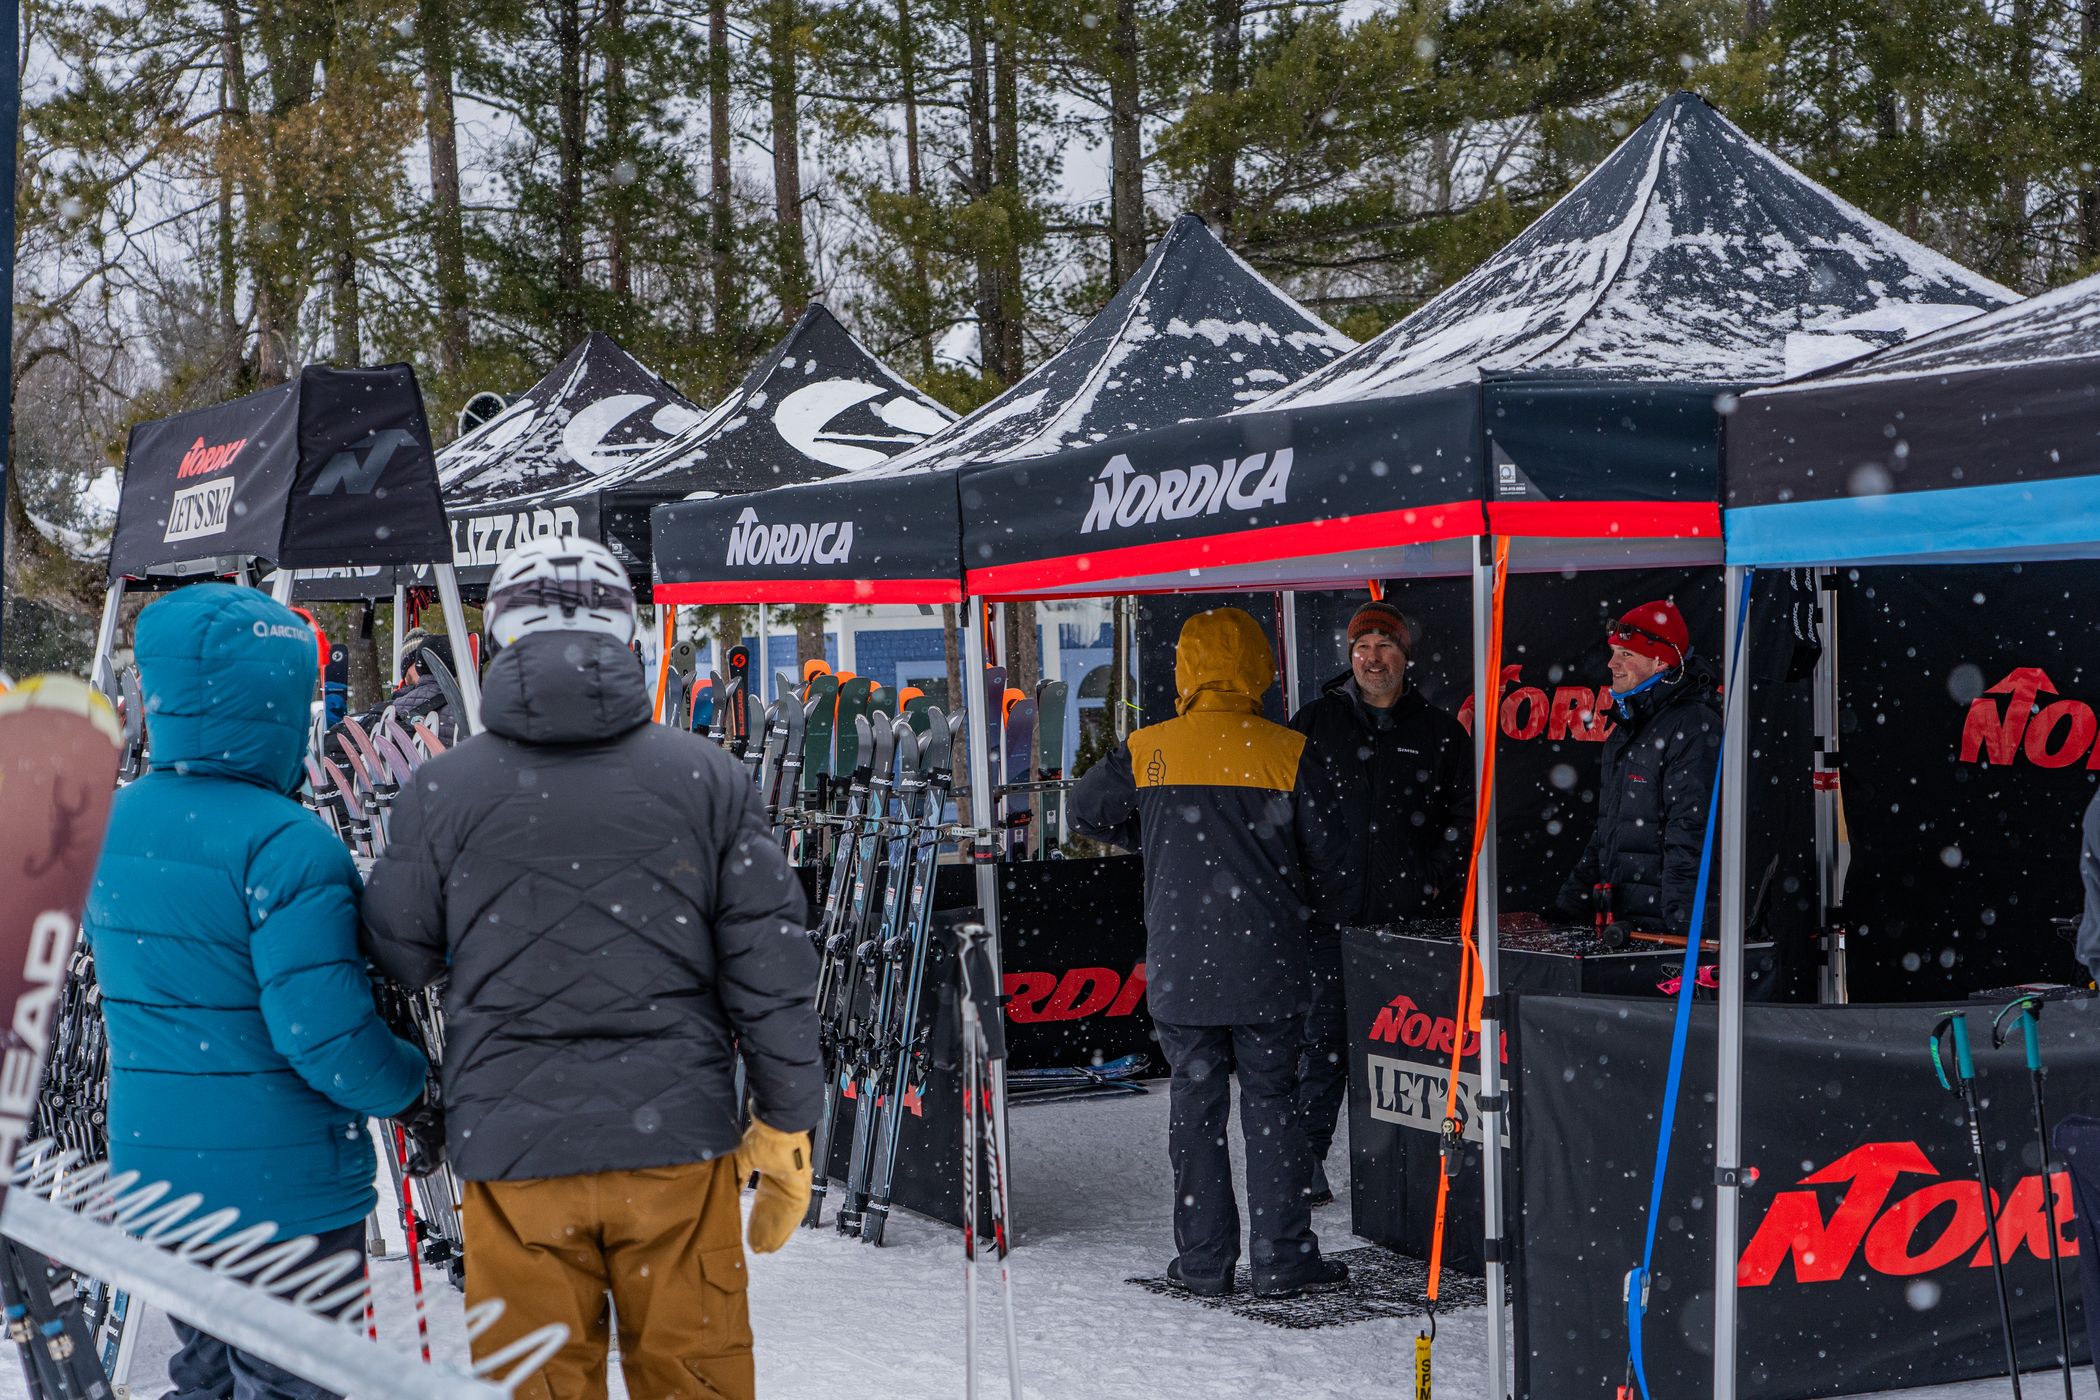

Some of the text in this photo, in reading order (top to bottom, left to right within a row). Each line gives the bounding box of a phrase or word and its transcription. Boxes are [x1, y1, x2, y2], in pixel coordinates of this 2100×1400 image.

[168, 486, 232, 534] LET'S SKI
[1080, 447, 1294, 535] NORDICA
[449, 506, 579, 568] LIZZARD
[726, 507, 853, 566] NORDICA
[1959, 667, 2100, 770] NO
[1002, 962, 1146, 1024] RDI
[0, 910, 73, 1183] HEAD
[1737, 1141, 2080, 1287] NOR
